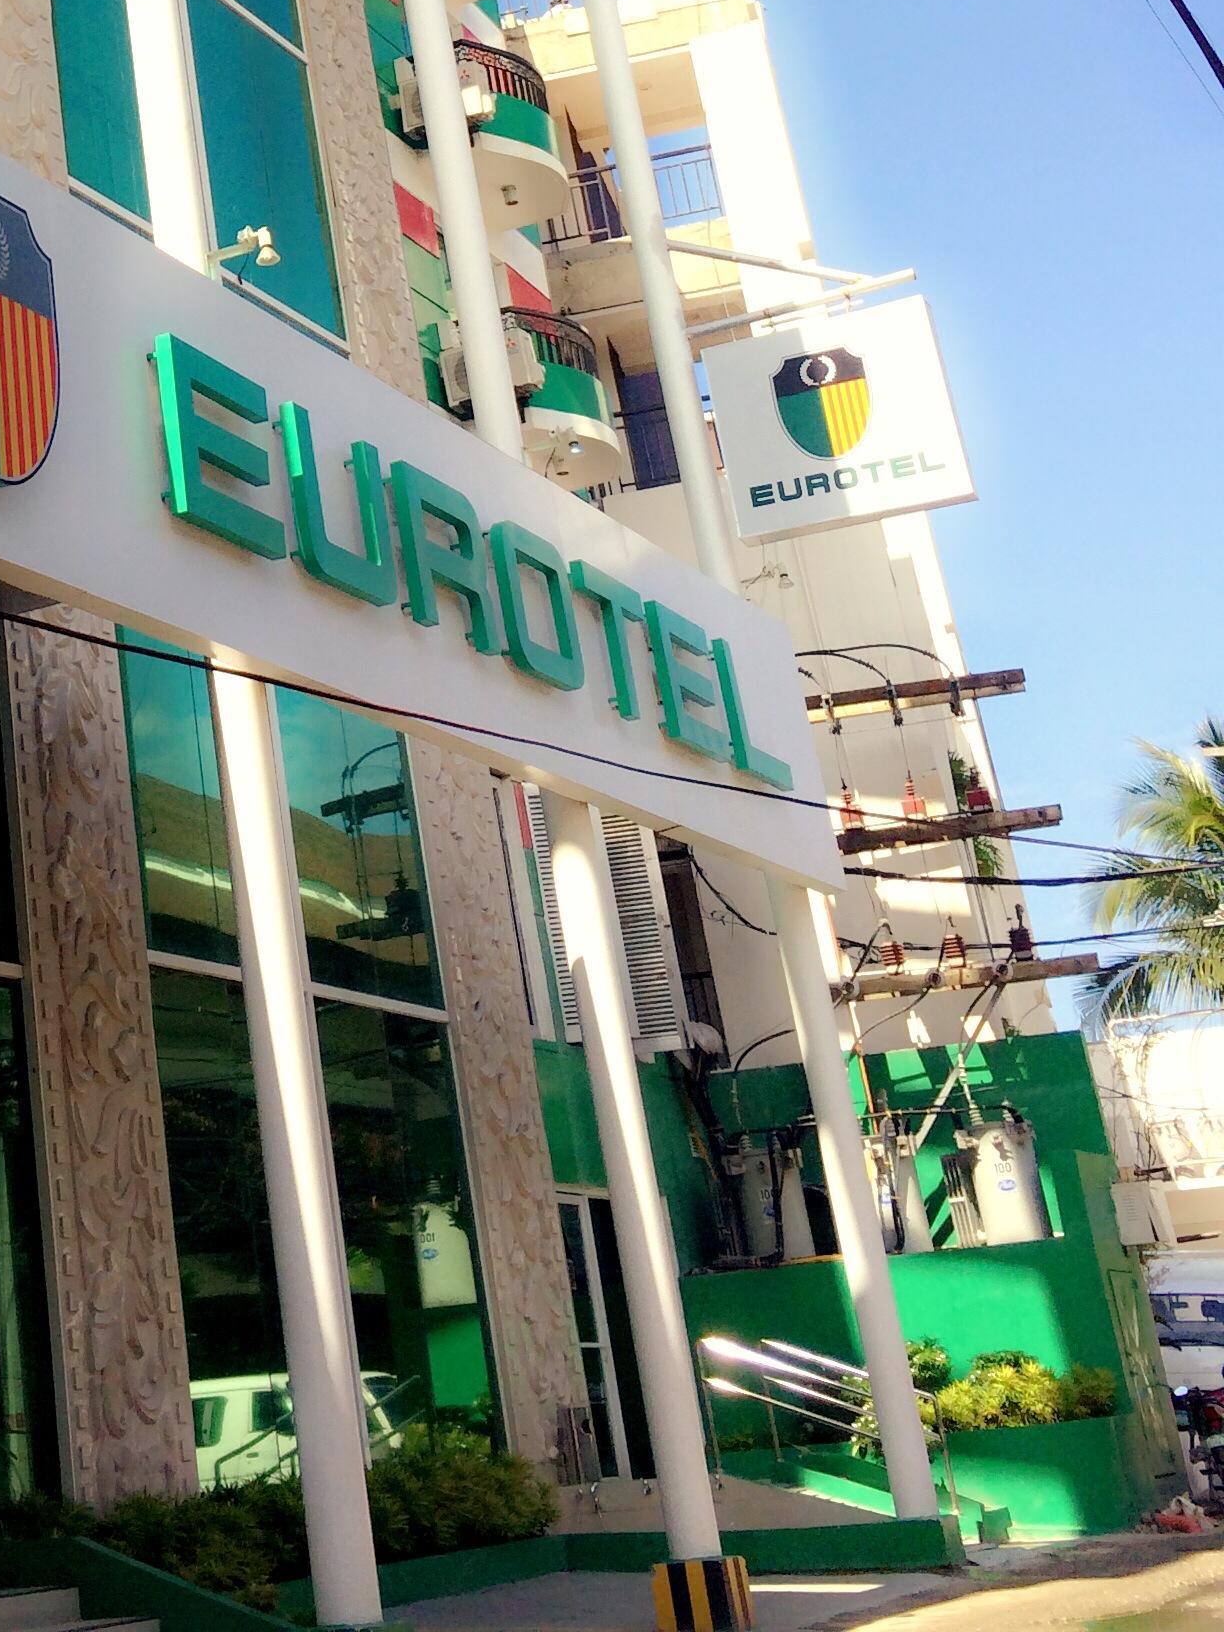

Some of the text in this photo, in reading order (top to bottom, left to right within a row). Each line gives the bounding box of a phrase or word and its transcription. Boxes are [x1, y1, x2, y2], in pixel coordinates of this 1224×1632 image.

[749, 452, 946, 507] EUROTEL
[153, 332, 794, 792] EUROTEL
[994, 1162, 1012, 1176] 100
